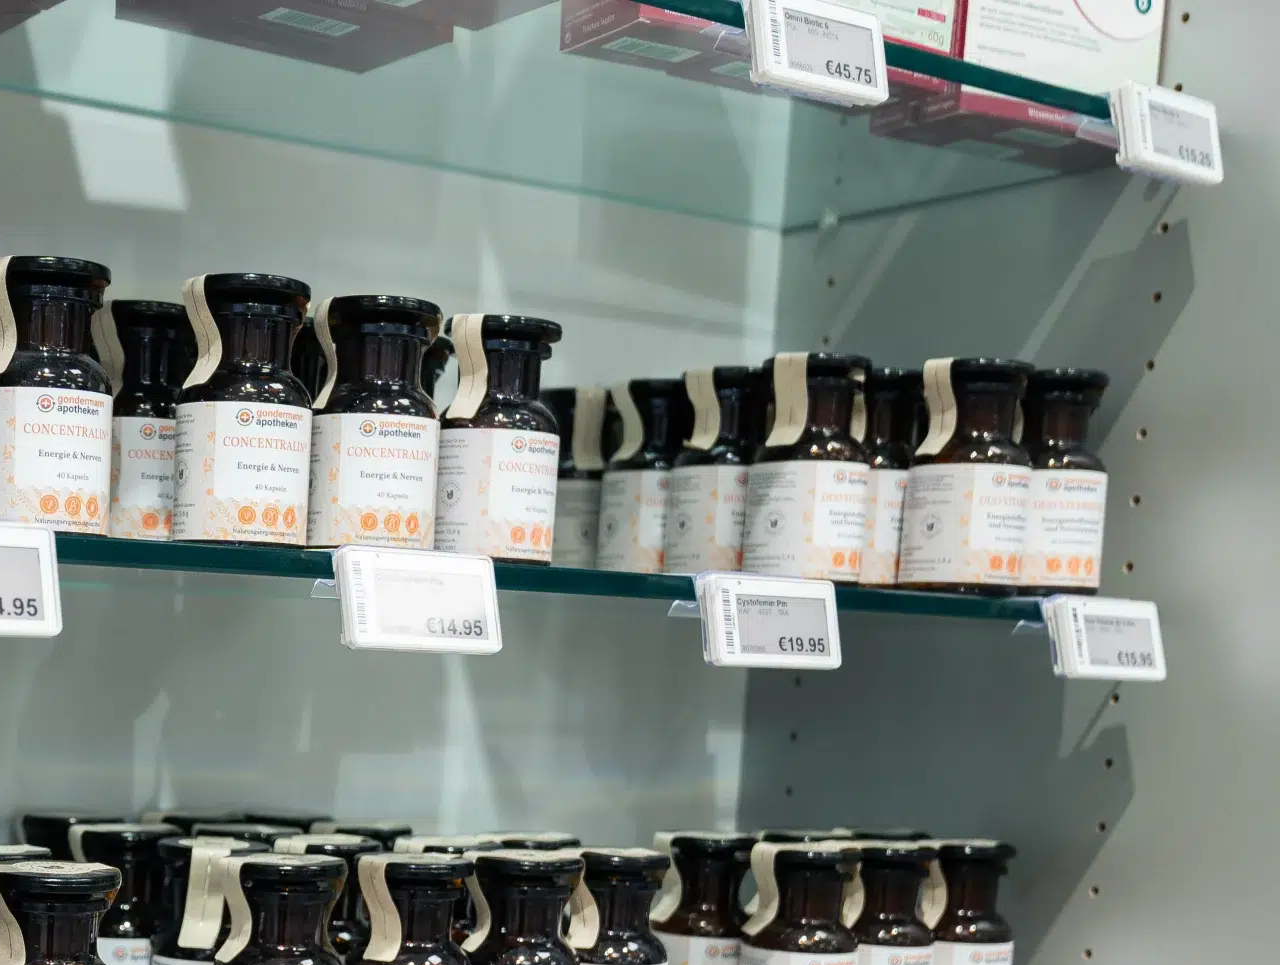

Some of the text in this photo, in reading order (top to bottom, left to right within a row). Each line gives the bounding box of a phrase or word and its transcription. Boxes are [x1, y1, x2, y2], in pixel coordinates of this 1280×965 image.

[826, 60, 872, 84] €45.75
[58, 395, 105, 409] gondermann
[57, 404, 100, 416] apotheken
[256, 408, 303, 422] gondermann
[255, 418, 298, 430] apotheken
[378, 419, 428, 432] gondermann
[378, 429, 422, 440] apotheken
[38, 449, 102, 463] Energie & Nerven
[237, 461, 300, 474] Energie & Nerven
[66, 472, 90, 482] Kapseln
[360, 470, 423, 483] Energie Nerven
[776, 599, 788, 608] Pm
[426, 616, 483, 637] €14.95
[778, 636, 825, 653] €19.95
[1117, 651, 1153, 667] €15.95
